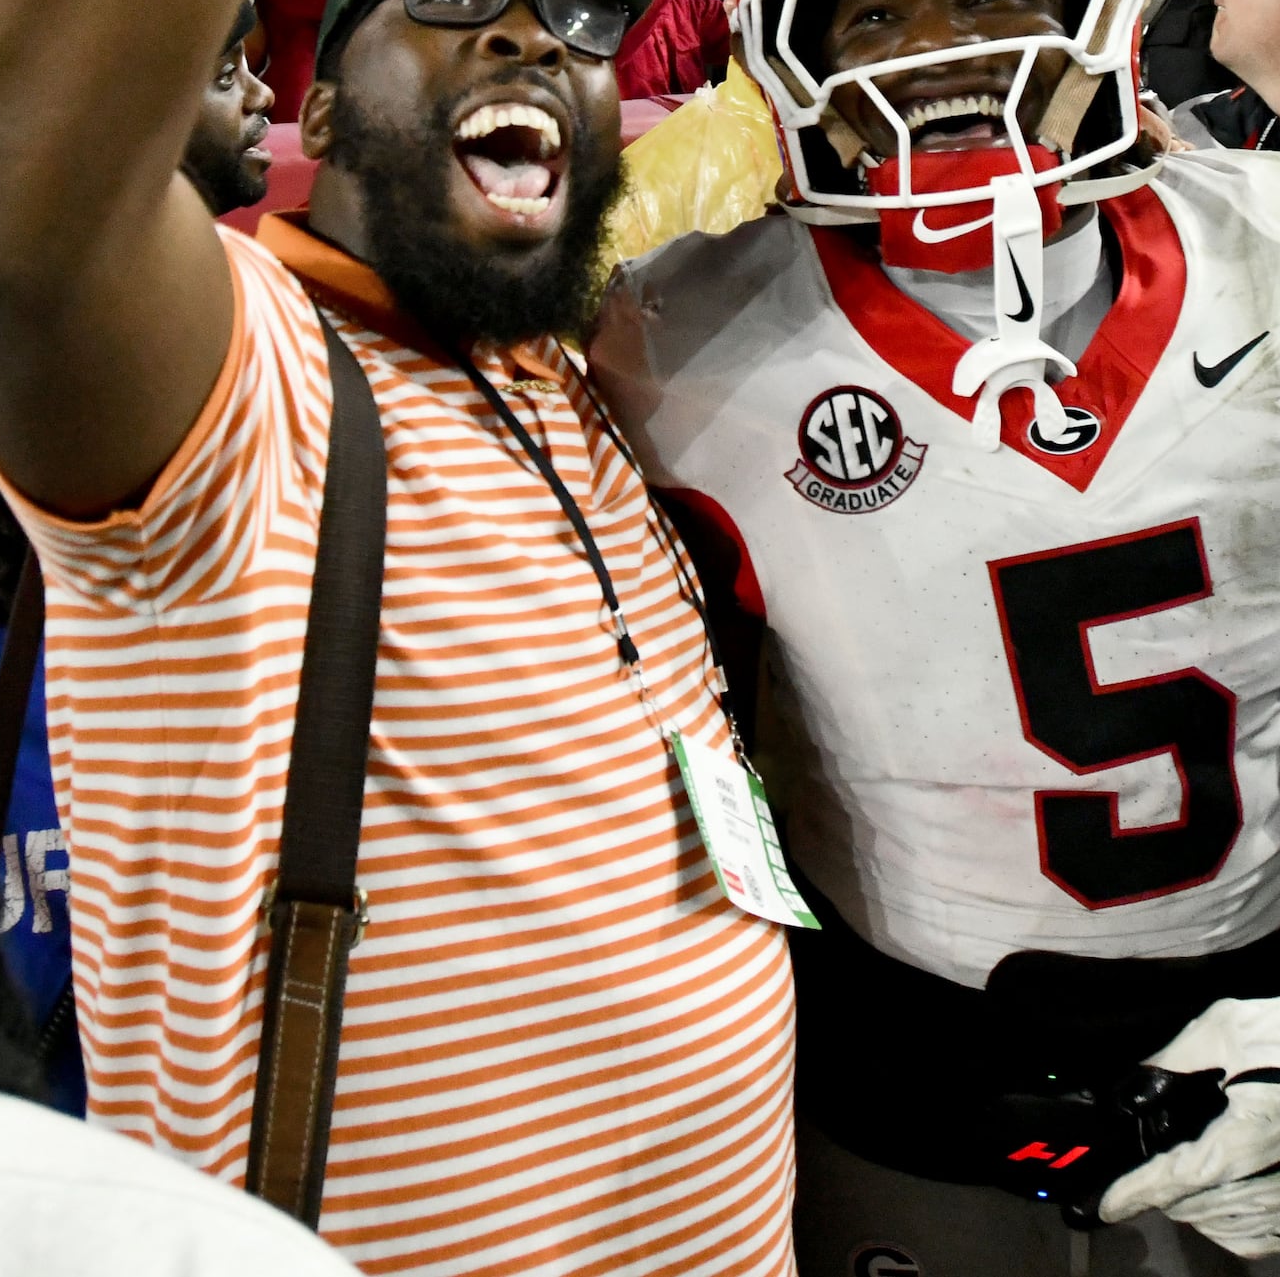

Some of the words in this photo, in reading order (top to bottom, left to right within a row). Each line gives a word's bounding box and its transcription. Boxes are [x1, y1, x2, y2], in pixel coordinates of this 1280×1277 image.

[806, 392, 894, 481] SEC
[806, 464, 913, 511] GRADUATE
[986, 515, 1245, 911] 5
